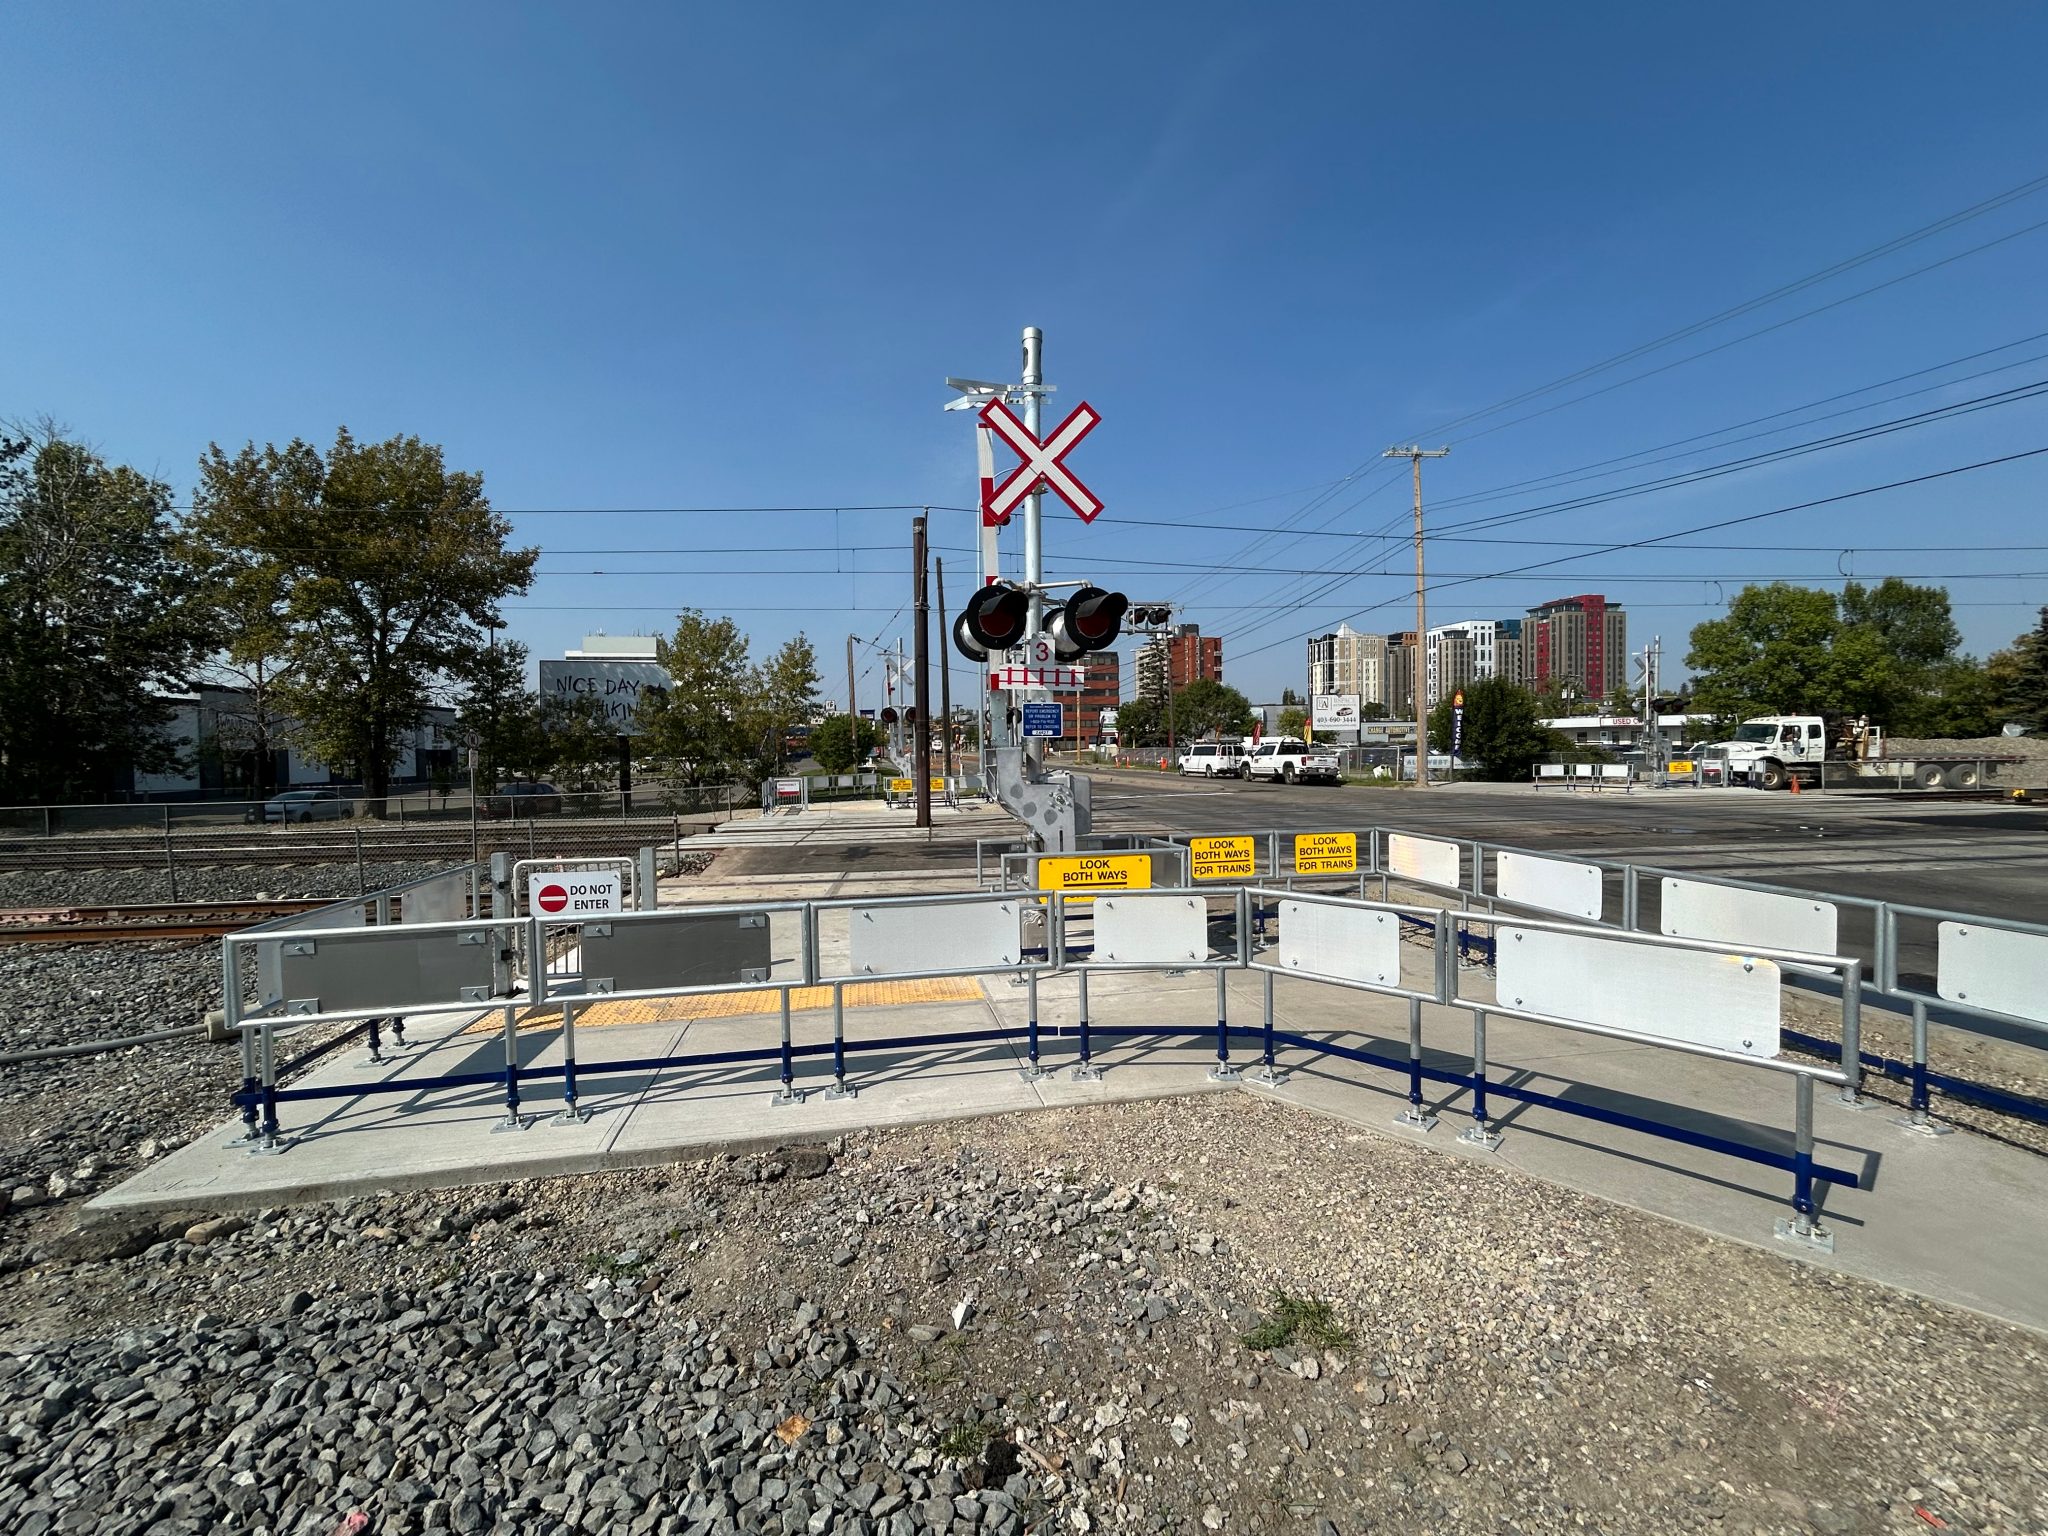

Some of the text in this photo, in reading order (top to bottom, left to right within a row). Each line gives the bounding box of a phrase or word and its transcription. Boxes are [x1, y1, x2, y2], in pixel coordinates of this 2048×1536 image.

[1036, 642, 1049, 661] 3
[556, 675, 640, 696] NICE DAY
[1209, 840, 1235, 849] LOOK
[1313, 837, 1338, 845] LOOK
[1195, 849, 1250, 860] BOTH WAYS
[1299, 845, 1352, 856] BOTH WAYS
[1079, 859, 1110, 869] LOOK
[1194, 863, 1251, 875] FOR TRAINS
[1298, 859, 1353, 870] FOR TRAINS
[1063, 870, 1128, 882] BOTH WAYS
[570, 884, 613, 896] DO NOT
[574, 898, 609, 910] ENTER
